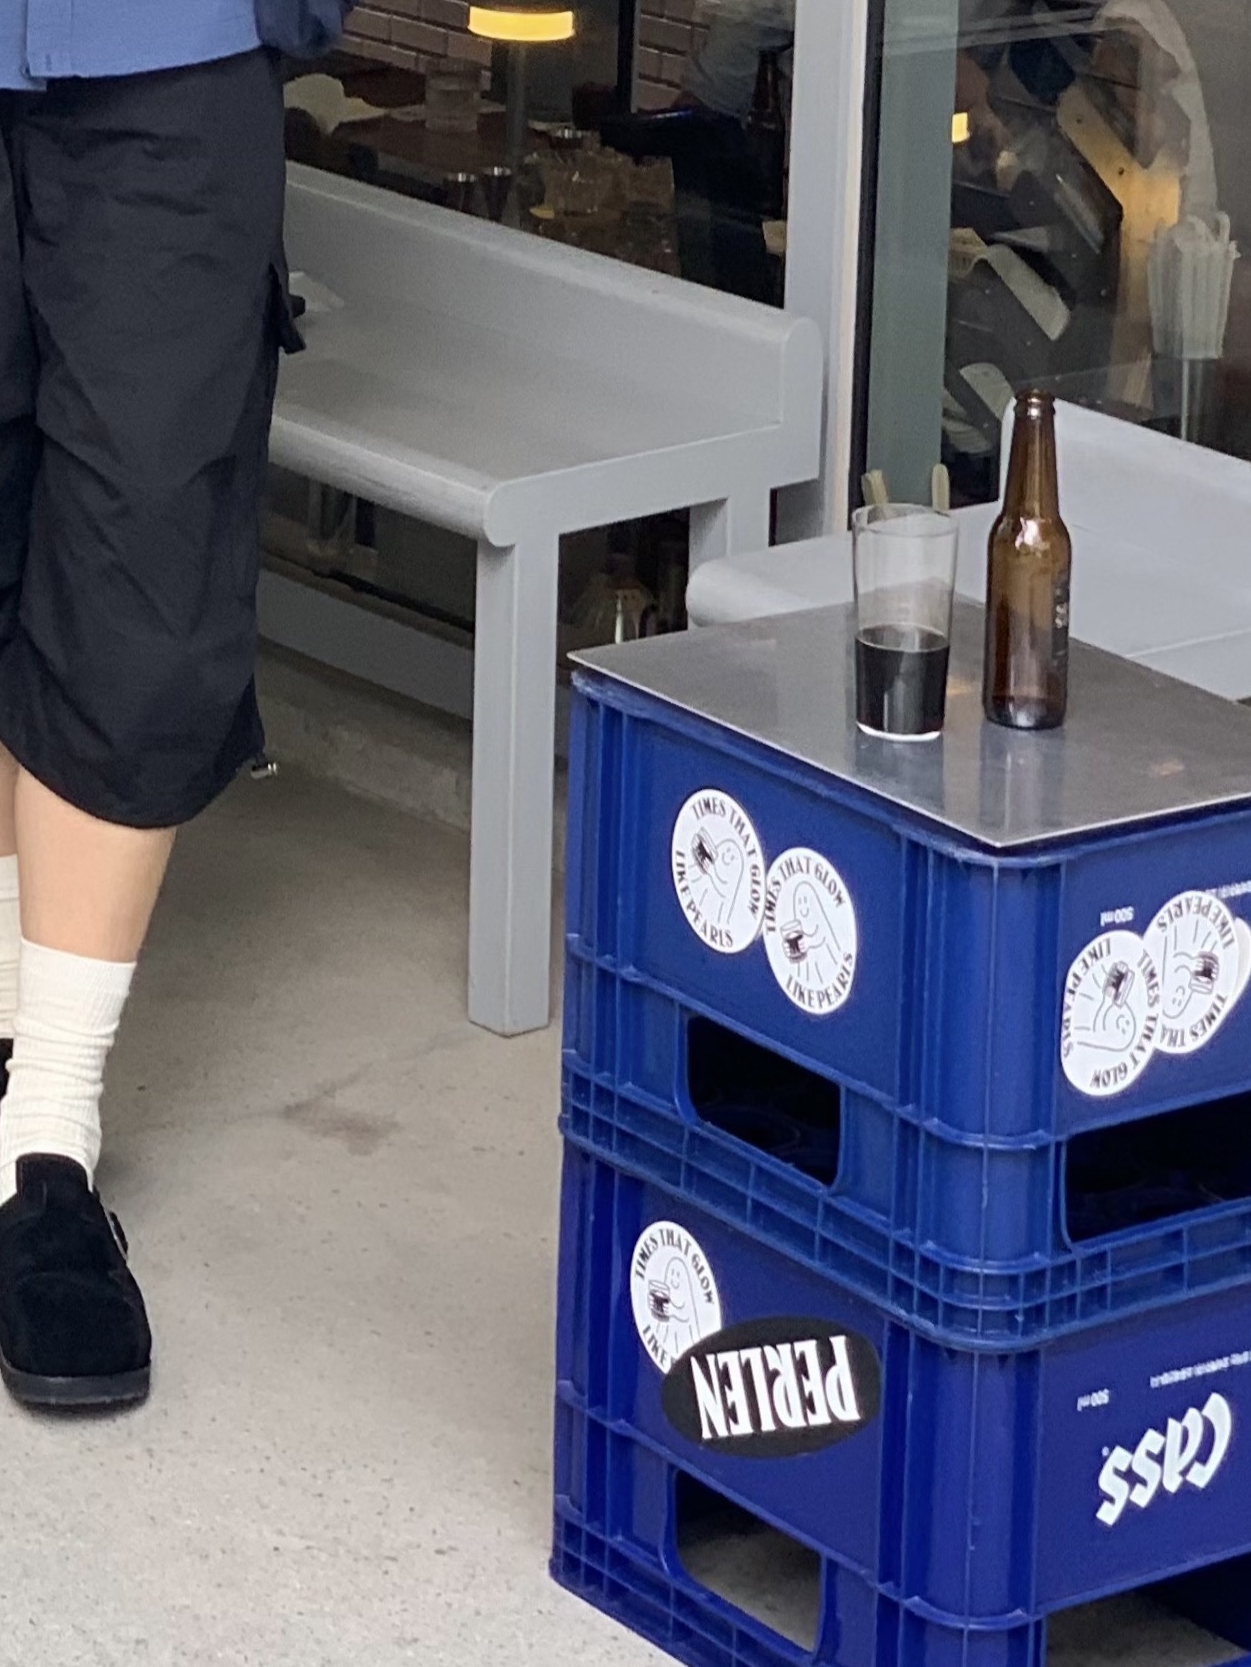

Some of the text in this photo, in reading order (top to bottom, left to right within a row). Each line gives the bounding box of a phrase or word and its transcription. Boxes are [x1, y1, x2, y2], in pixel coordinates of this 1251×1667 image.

[675, 850, 733, 948] LIKE PEARLS
[691, 796, 760, 919] TIMES THAT GLOW
[764, 856, 846, 935] TIMES THAT GLOW
[1156, 895, 1235, 949] LIKE PEARLS
[786, 952, 853, 1009] LIKE PEARLS
[1062, 937, 1111, 1058] LIKE PEARLS
[1090, 949, 1160, 1089] TIMES THAT GLOW
[1160, 993, 1228, 1048] TIMES THA
[634, 1228, 714, 1305] TIMES THAT GLOW
[642, 1325, 670, 1365] LIKE
[690, 1335, 861, 1439] PERLEN
[1096, 1392, 1231, 1526] Cass
